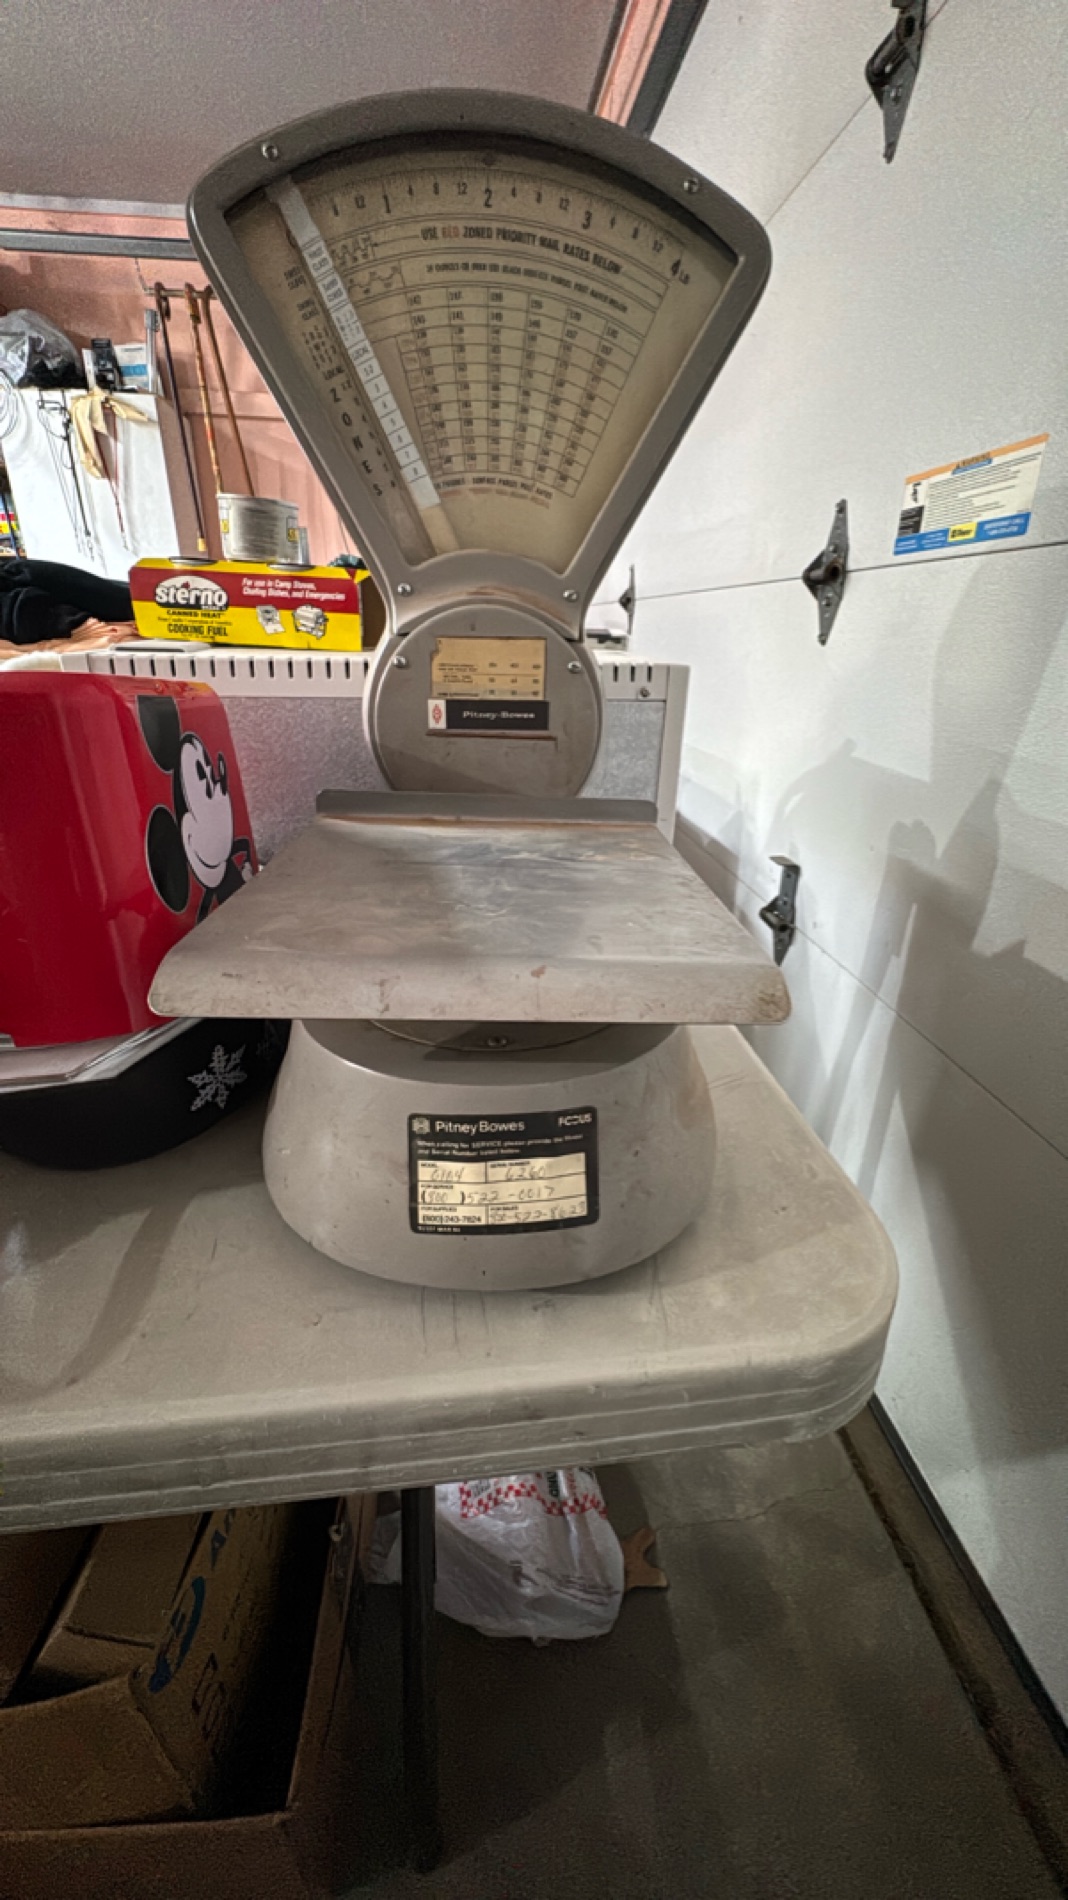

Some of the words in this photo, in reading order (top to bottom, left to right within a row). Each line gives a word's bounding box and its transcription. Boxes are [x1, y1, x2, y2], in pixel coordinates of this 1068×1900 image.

[456, 181, 468, 196] 12
[484, 187, 493, 209] 2
[581, 210, 593, 230] 3
[420, 226, 438, 241] USE
[463, 226, 493, 239] ZONED
[496, 226, 537, 246] PRIORITY
[563, 242, 590, 262] RATES
[592, 253, 622, 275] BELOW
[242, 577, 252, 587] For
[155, 587, 228, 606] sterno
[291, 590, 304, 598] and
[305, 590, 346, 601] Emergencies
[167, 609, 199, 617] CANNED
[168, 623, 204, 635] COOKING
[207, 625, 228, 637] FUEL
[434, 1120, 478, 1137] Pitney
[479, 1120, 525, 1134] Bowes
[471, 1140, 502, 1149] SERVICE
